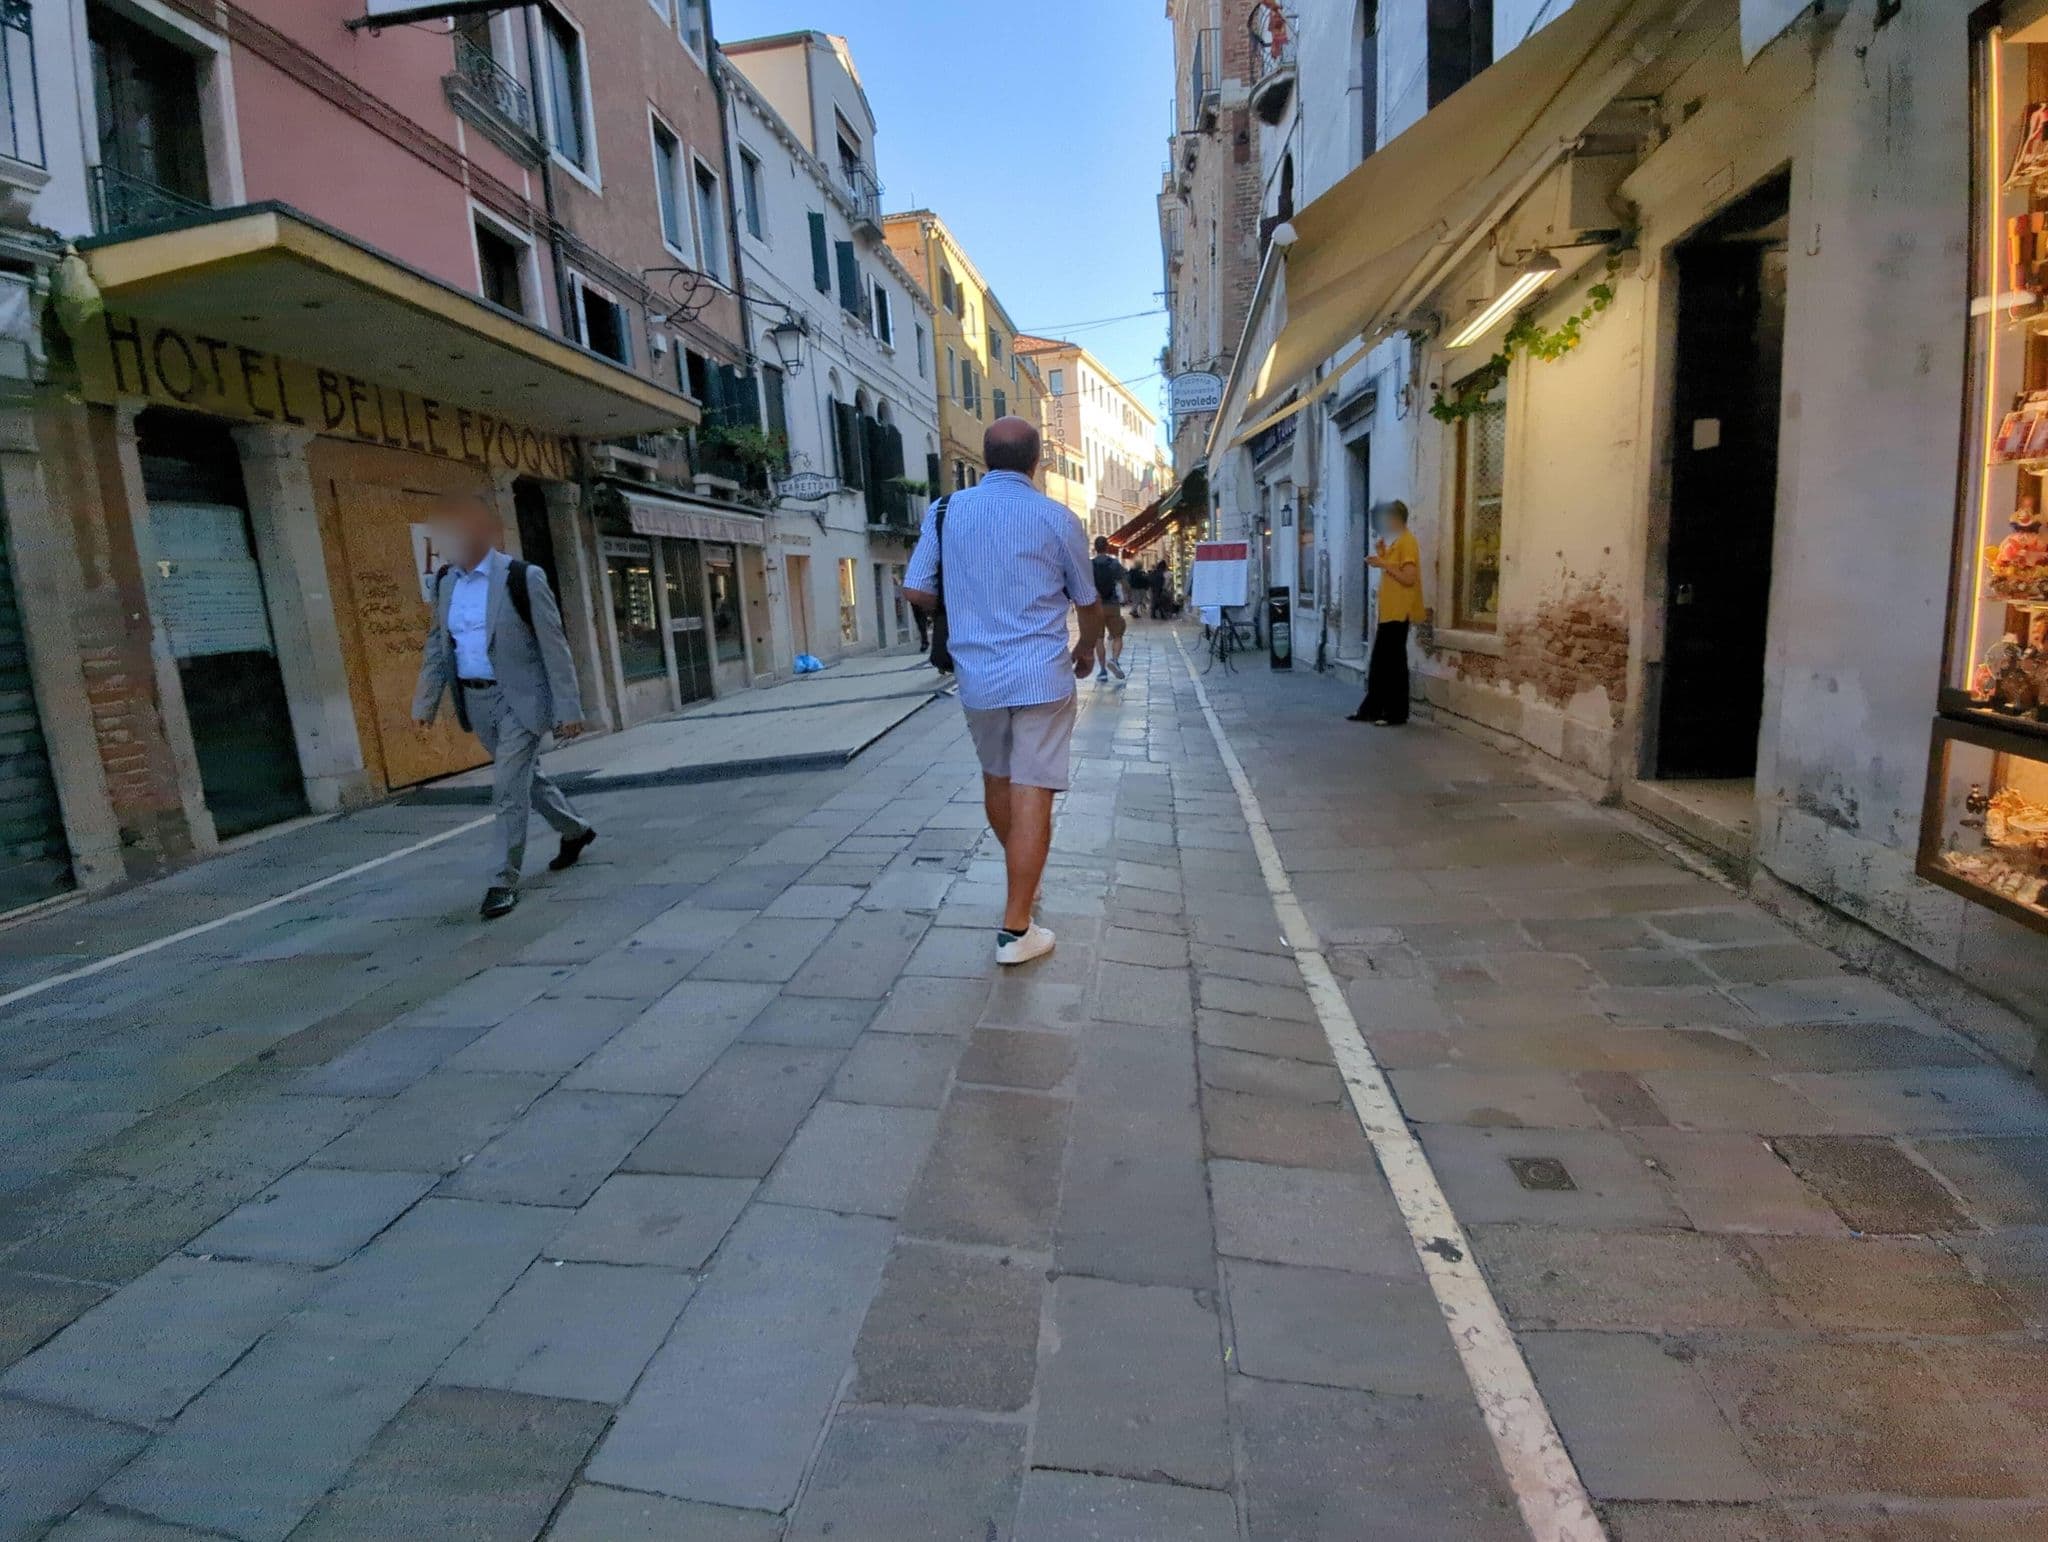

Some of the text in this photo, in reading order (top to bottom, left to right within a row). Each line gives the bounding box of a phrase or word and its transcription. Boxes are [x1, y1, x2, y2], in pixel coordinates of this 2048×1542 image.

[104, 309, 305, 426] HOTEL
[317, 367, 449, 455] BELLE
[1174, 395, 1218, 408] Povoledo
